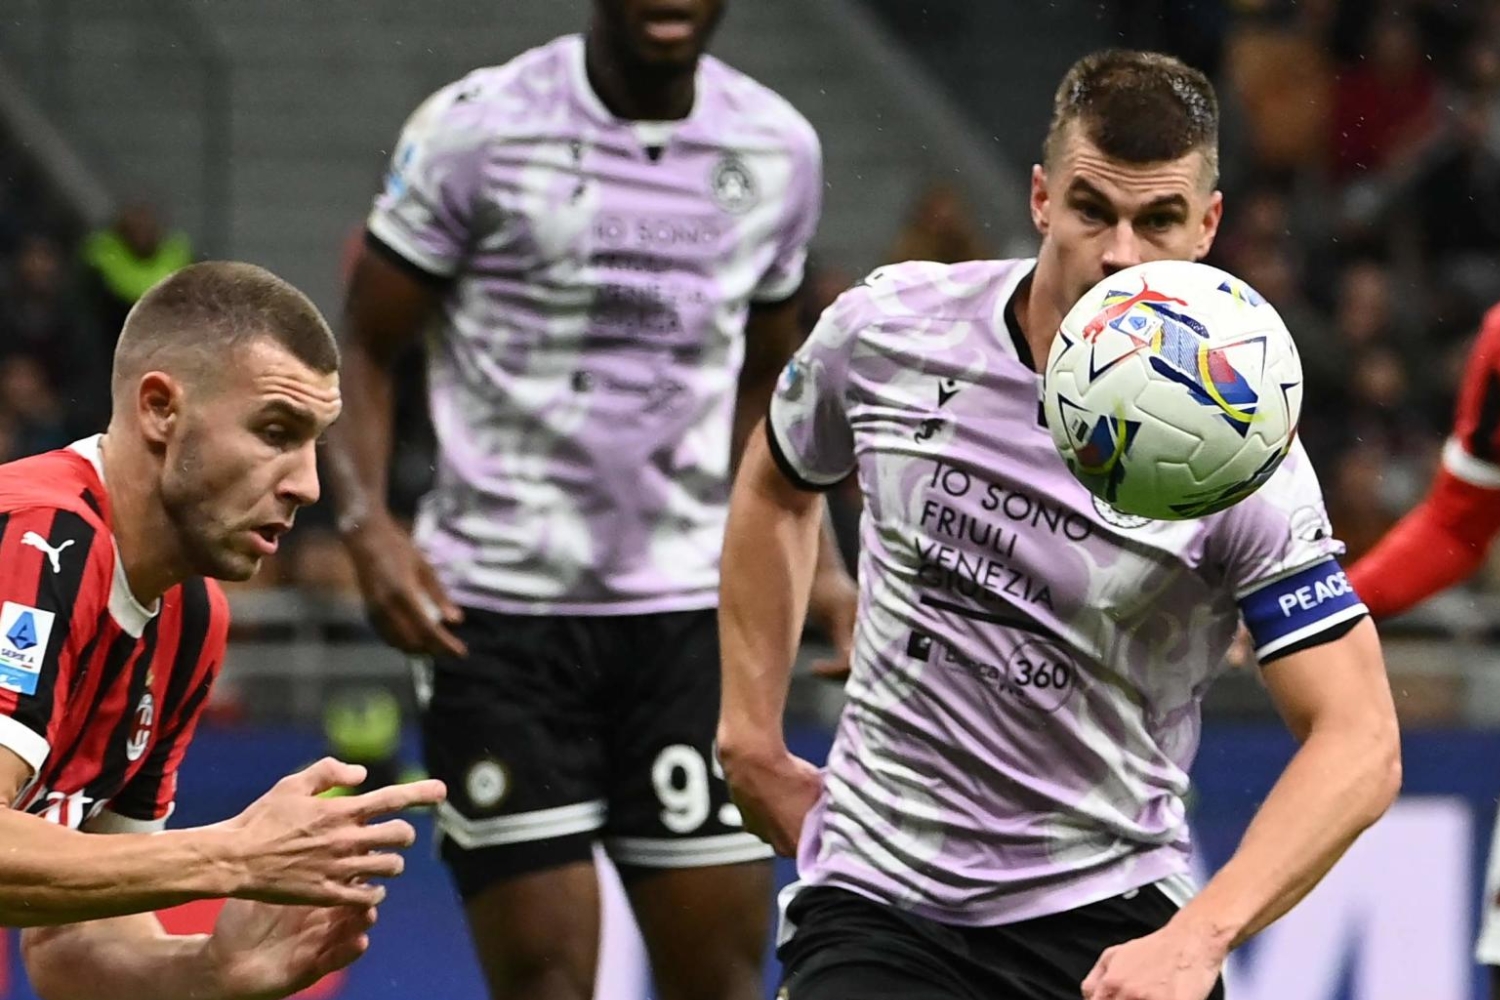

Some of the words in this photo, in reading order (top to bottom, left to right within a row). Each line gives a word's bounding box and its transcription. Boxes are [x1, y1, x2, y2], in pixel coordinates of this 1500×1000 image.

[920, 500, 1018, 559] FRIULI
[930, 460, 971, 497] IO
[981, 483, 1092, 541] SONO
[915, 537, 1056, 611] VENEZIA
[1278, 571, 1353, 618] PEACE
[1014, 658, 1072, 690] 360
